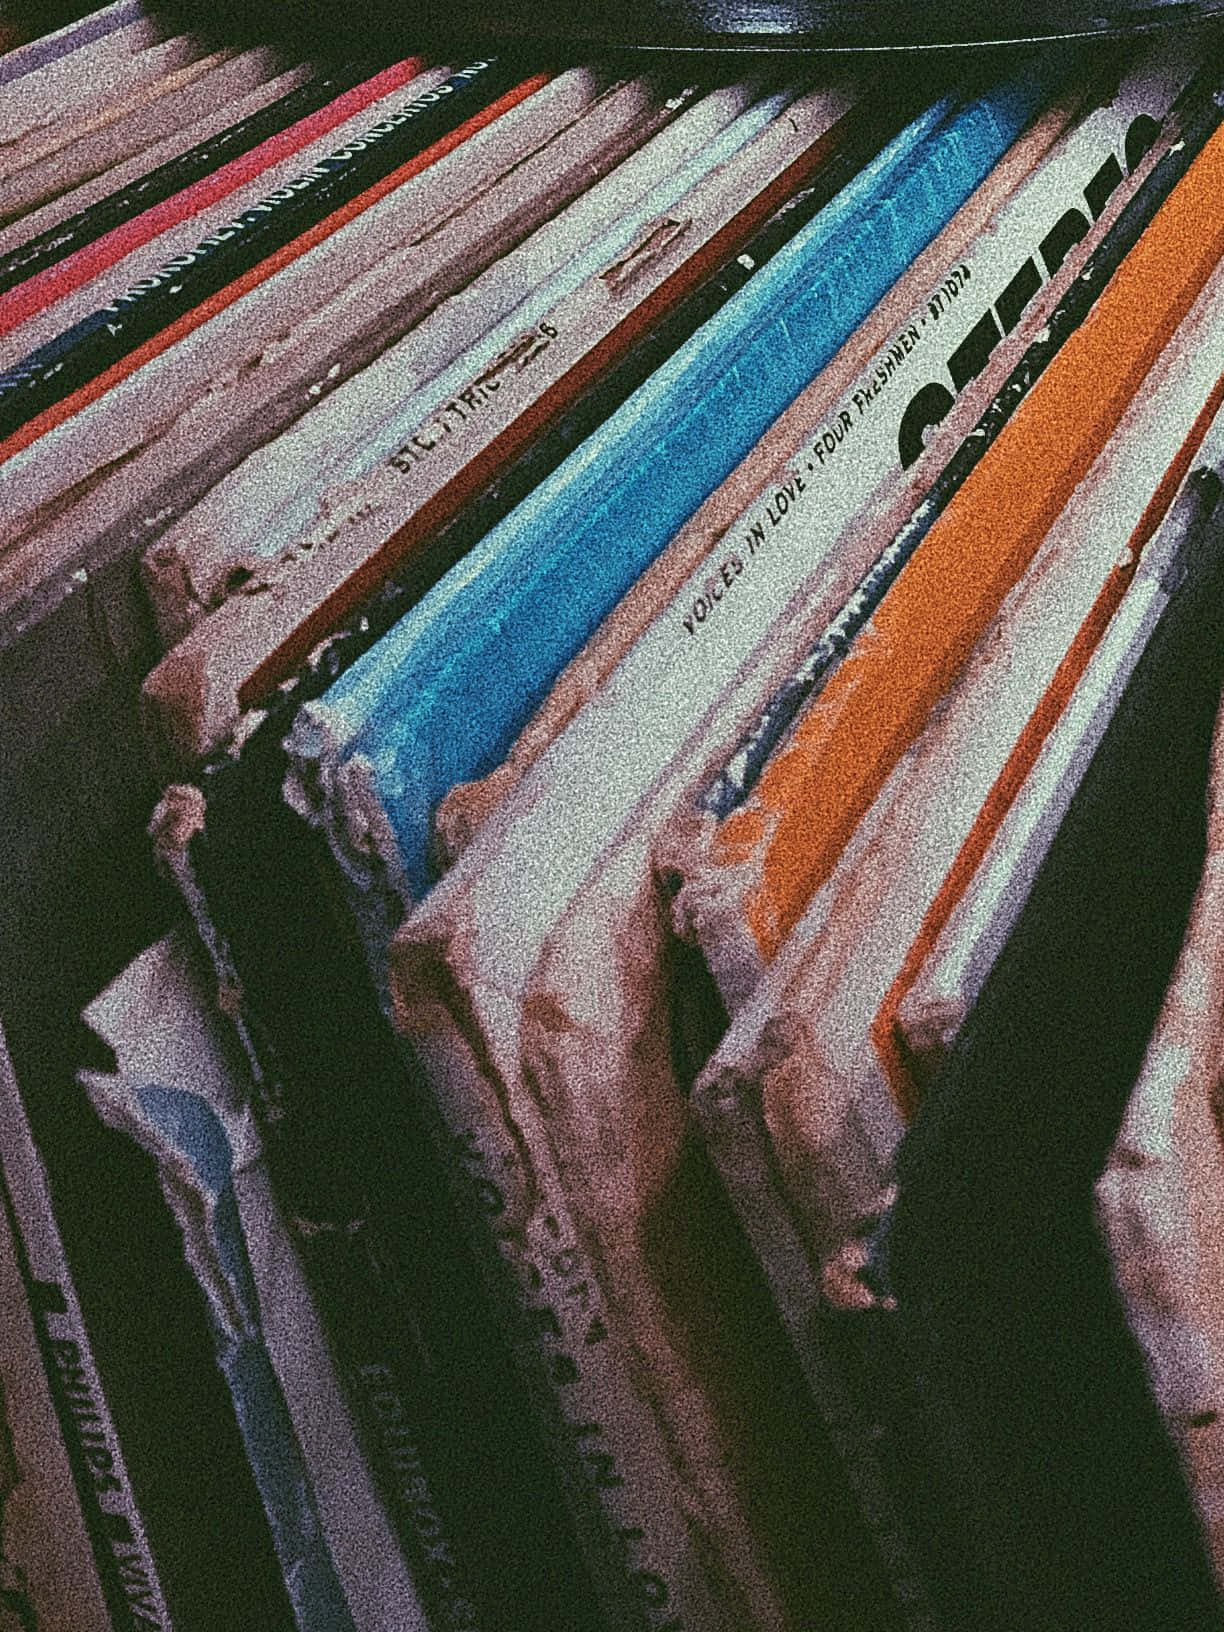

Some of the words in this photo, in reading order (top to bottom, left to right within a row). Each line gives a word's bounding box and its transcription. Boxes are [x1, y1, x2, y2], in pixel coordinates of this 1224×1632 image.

[682, 558, 744, 635] VOICES
[745, 529, 766, 558] IN
[767, 474, 808, 528] LOVE
[812, 410, 855, 467] FOUR
[857, 323, 922, 416] FRESHMEN
